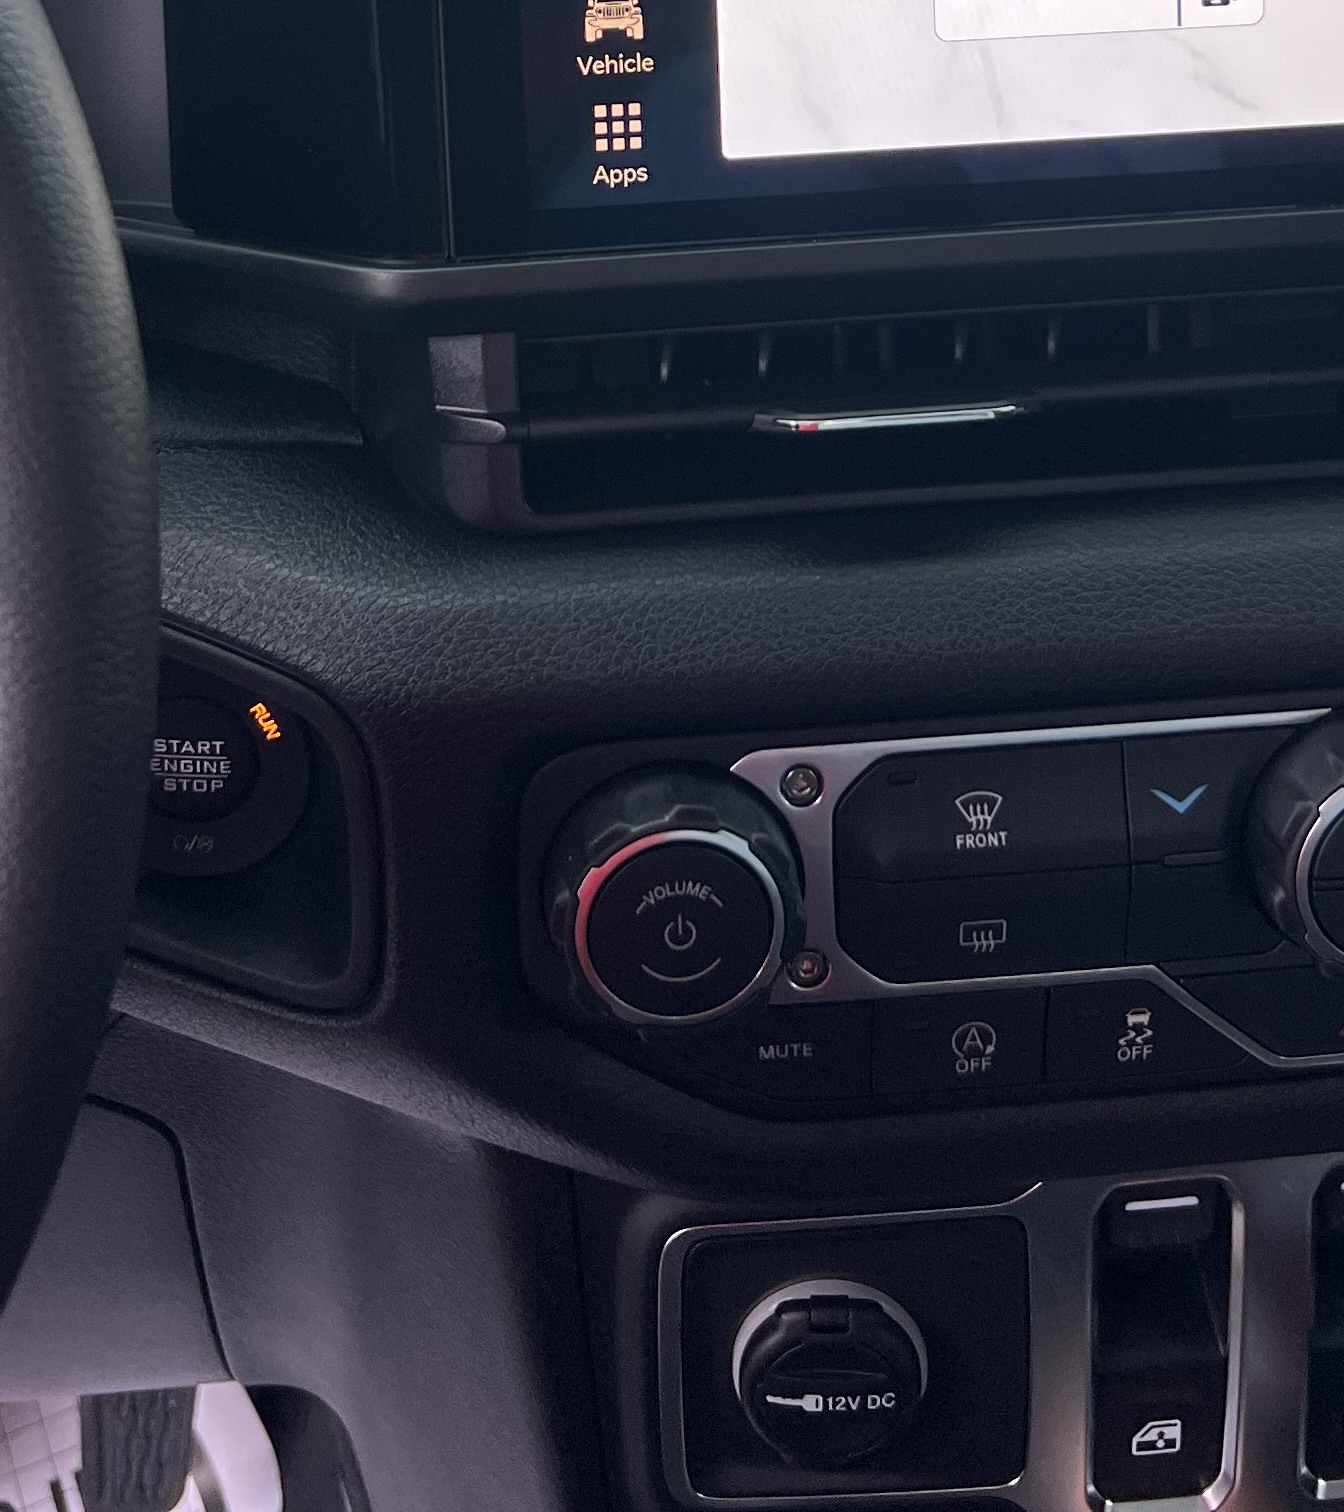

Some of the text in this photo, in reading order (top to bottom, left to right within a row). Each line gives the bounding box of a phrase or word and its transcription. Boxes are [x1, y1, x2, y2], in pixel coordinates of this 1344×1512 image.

[577, 52, 654, 76] Vehicle
[592, 165, 649, 188] Apps
[249, 702, 282, 741] RUN
[153, 738, 225, 755] START
[150, 758, 232, 774] ENGINE
[163, 778, 224, 793] STOP
[955, 831, 1008, 849] FRONT
[642, 880, 713, 906] VOLUME
[758, 1042, 814, 1061] MUTE
[1116, 1044, 1153, 1063] OFF
[955, 1056, 993, 1074] OFF
[825, 1392, 896, 1412] 12V DC
